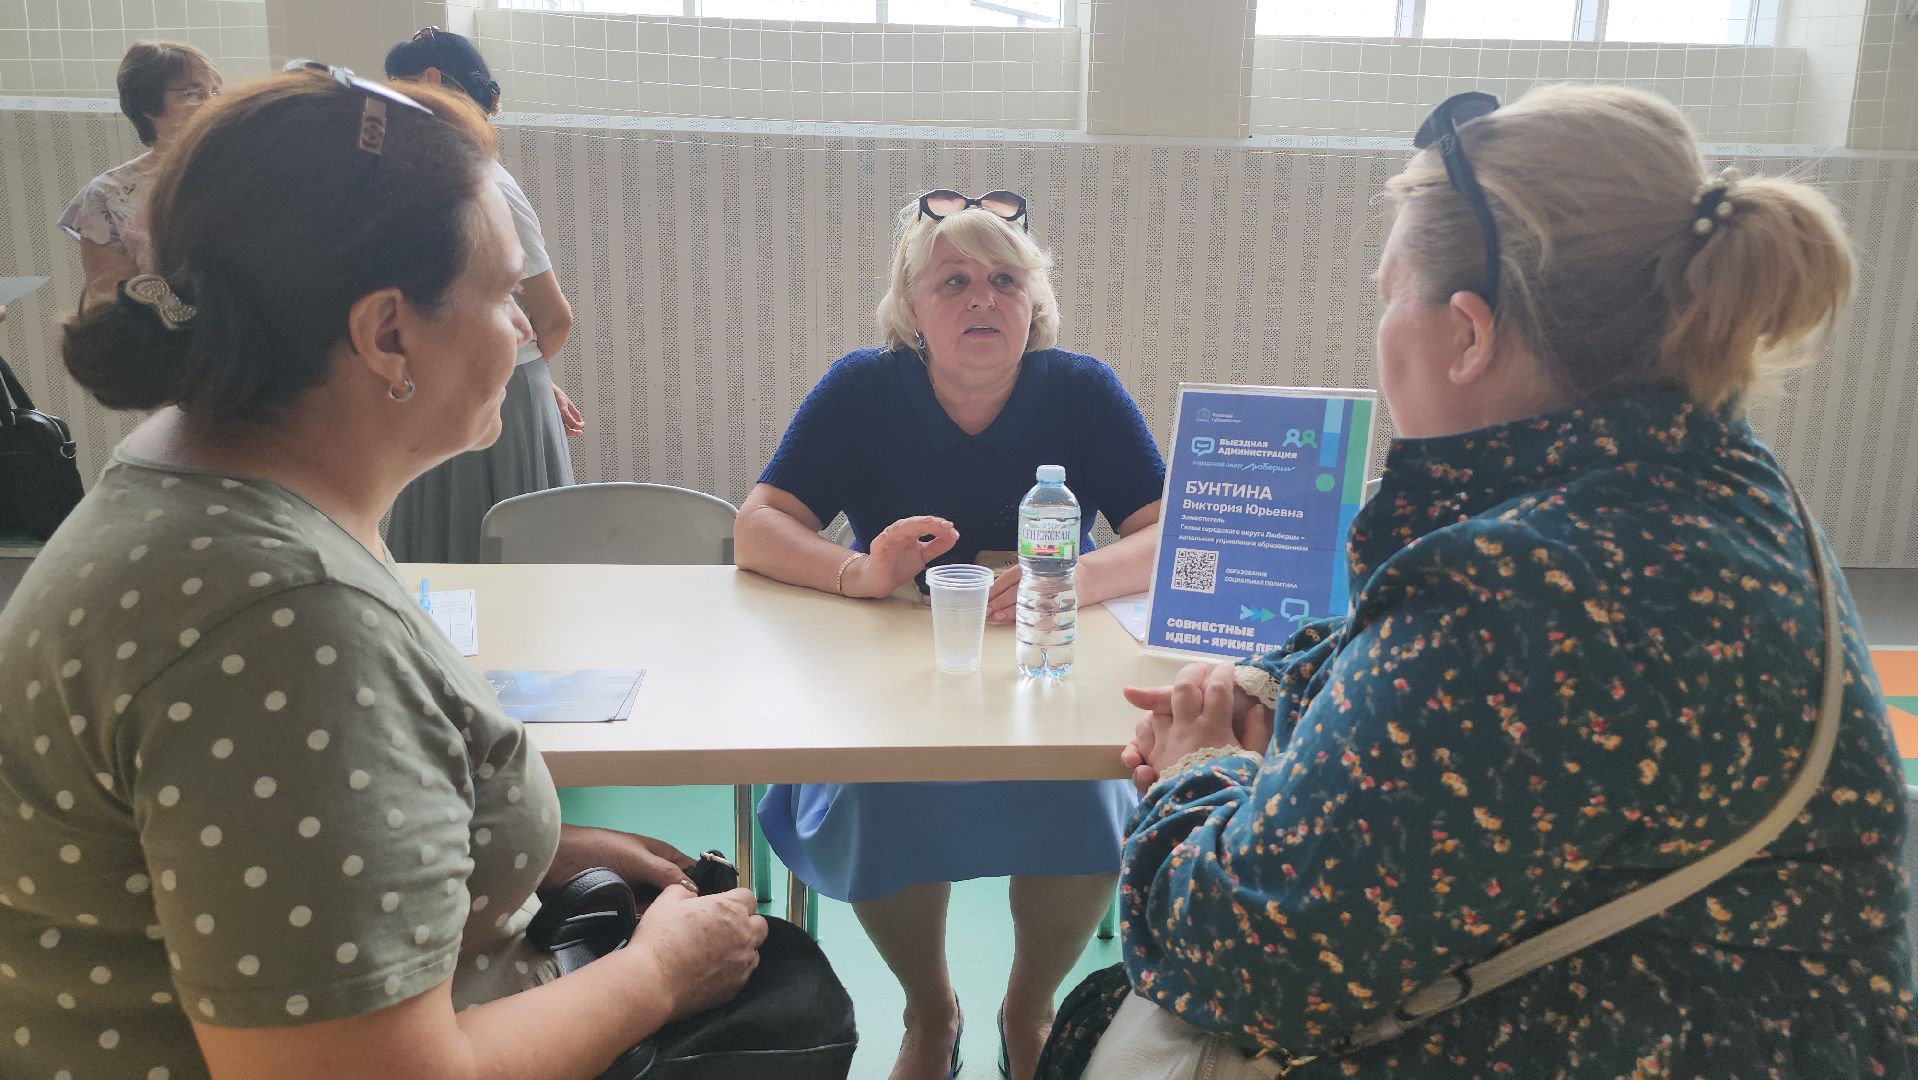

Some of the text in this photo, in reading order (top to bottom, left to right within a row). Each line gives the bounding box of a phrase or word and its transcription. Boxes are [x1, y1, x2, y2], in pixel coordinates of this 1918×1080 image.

[1219, 438, 1269, 448] ВЫЕЗДНАЯ
[1217, 447, 1298, 459] АДМИНИСТРАЦИЯ
[1185, 480, 1273, 500] БУНТИНА
[1182, 499, 1304, 518] Виктория Юрьевна
[1180, 514, 1225, 524] Заместитель
[1022, 528, 1071, 541] СЕНЕЖСКАЯ
[1240, 530, 1265, 538] округа
[1265, 531, 1300, 541] Люберцы
[1256, 540, 1309, 552] образованием
[1225, 567, 1268, 577] ОБРАЗОВАНИЕ
[1224, 576, 1298, 589] СОЦИАЛЬНАЯ ПОЛИТИКА
[1166, 617, 1255, 637] СОВМЕСТНЫЕ
[1165, 631, 1202, 645] ИДЕИ
[1211, 637, 1255, 652] ЯРКИЕ
